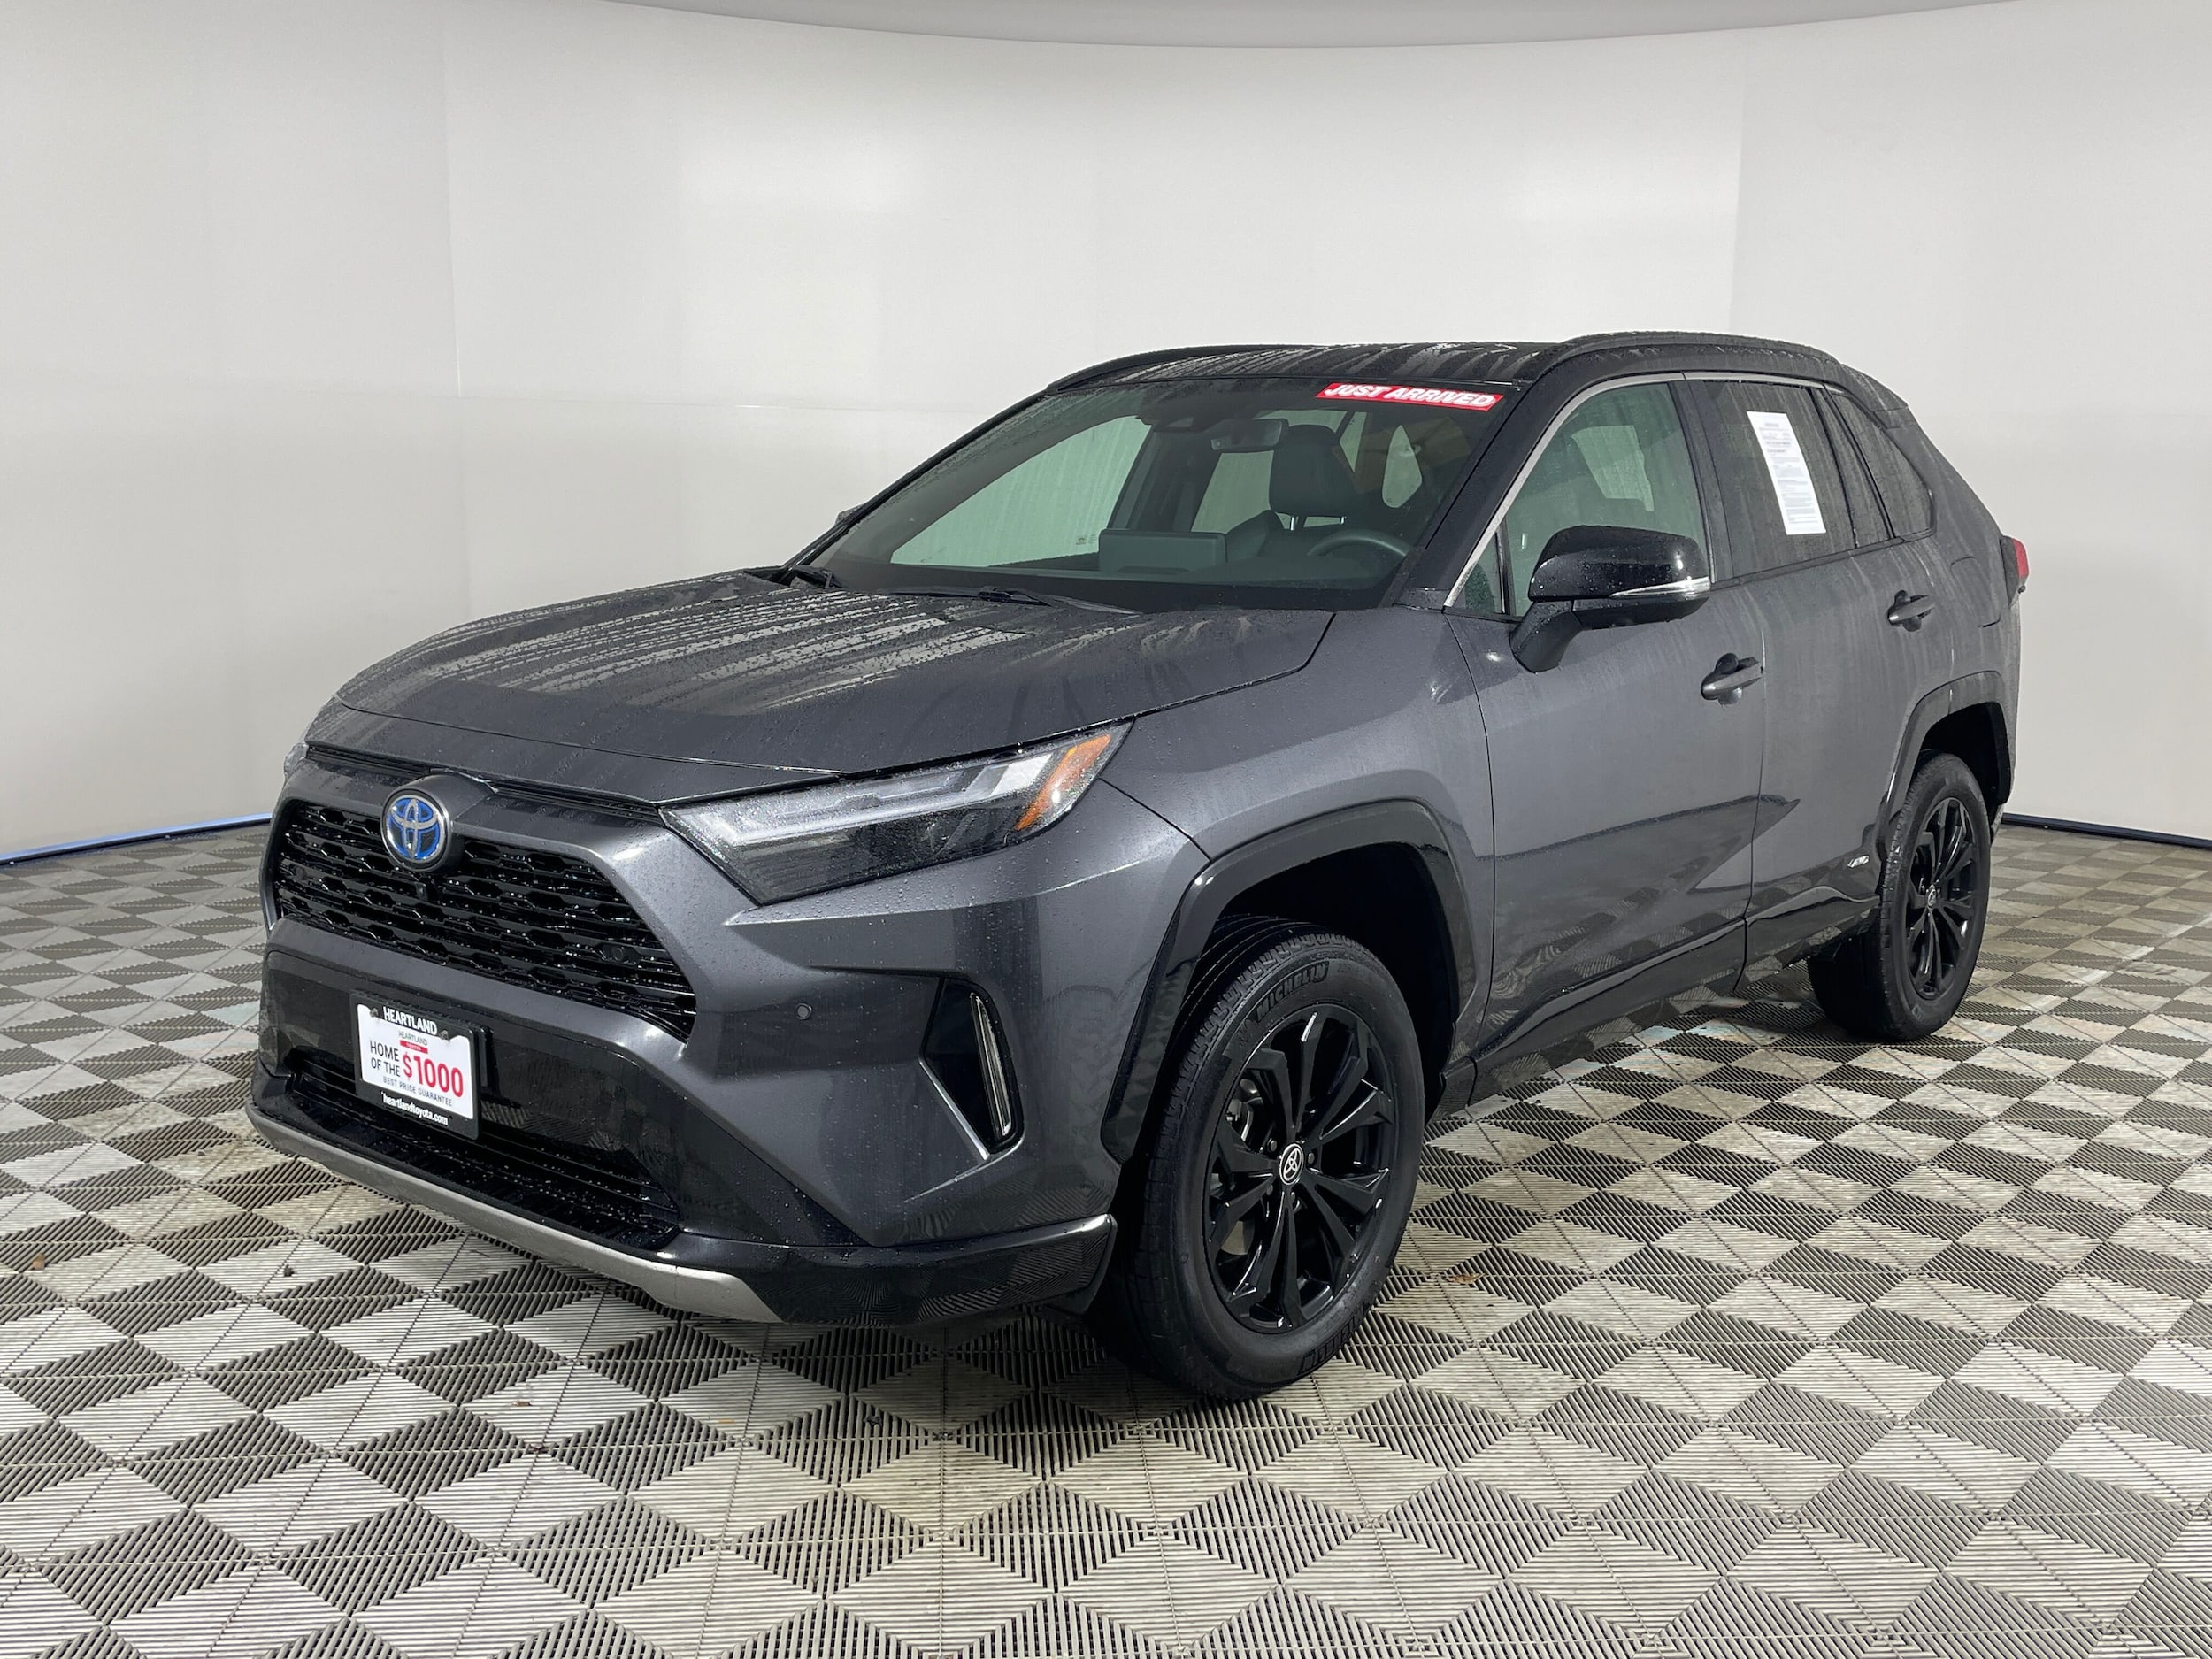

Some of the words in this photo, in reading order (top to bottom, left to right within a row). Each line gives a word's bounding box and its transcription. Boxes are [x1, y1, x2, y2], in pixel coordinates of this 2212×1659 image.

[1324, 384, 1392, 399] JUST
[1385, 388, 1496, 407] ARRIVED
[1256, 961, 1329, 1022] MICHELIN
[382, 1006, 438, 1035] HEARTLAND
[370, 1040, 400, 1062] HOME
[398, 1031, 428, 1046] HEARTLAND
[371, 1057, 381, 1071] OF
[384, 1061, 401, 1077] THE
[403, 1051, 464, 1098] $1000
[382, 1076, 397, 1088] BEST
[399, 1081, 417, 1094] PRICE
[418, 1087, 453, 1108] GUARANTEE
